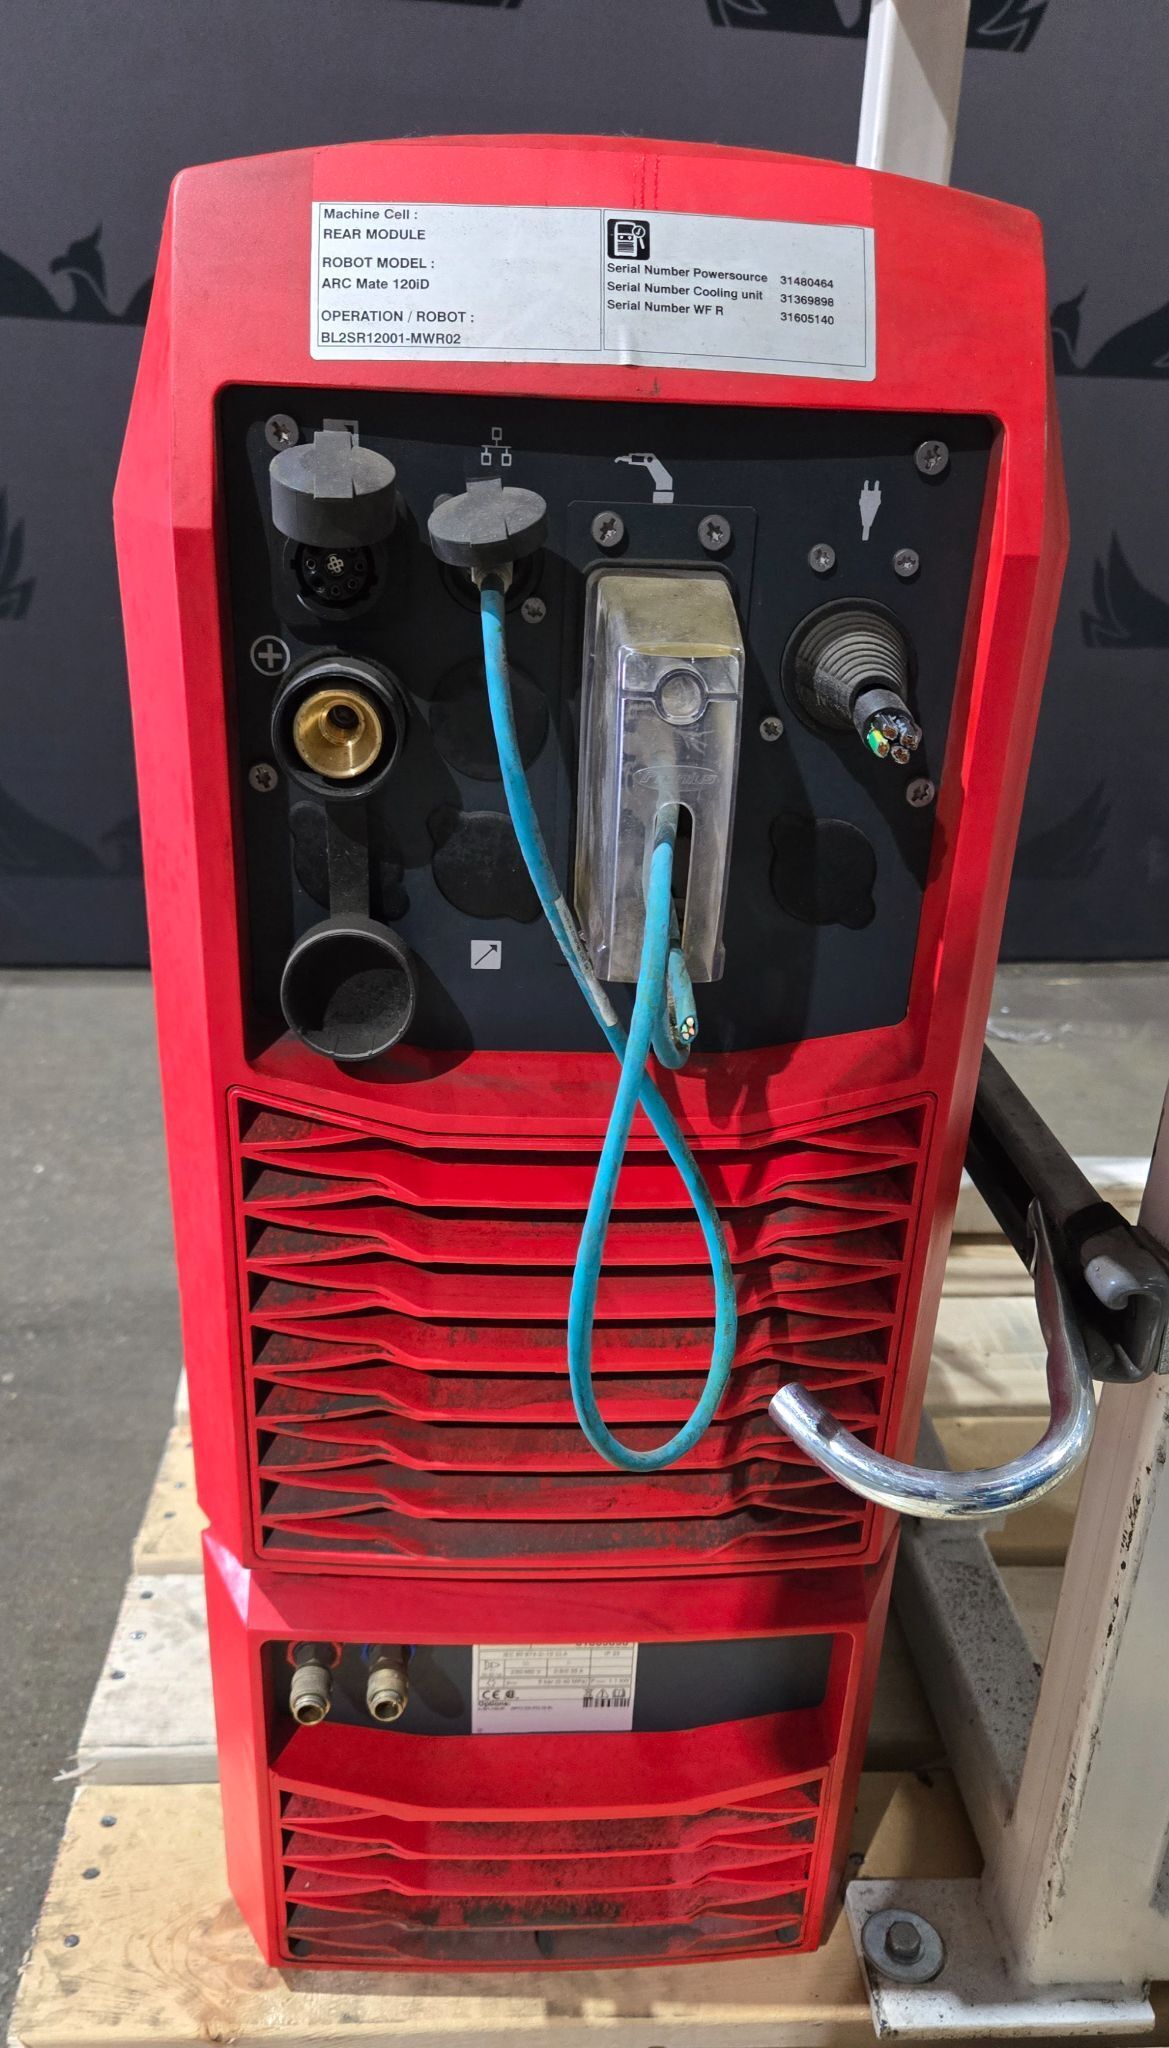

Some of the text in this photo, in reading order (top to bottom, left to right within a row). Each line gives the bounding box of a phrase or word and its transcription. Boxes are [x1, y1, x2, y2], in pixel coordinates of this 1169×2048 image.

[323, 209, 380, 219] Machine
[384, 209, 410, 220] Cell
[323, 229, 425, 240] REAR MODULE
[322, 258, 372, 268] ROBOT
[377, 258, 427, 269] MODEL
[607, 263, 834, 288] Serial Number Powersource 31480464
[322, 279, 430, 290] ARC Mate 120iD
[607, 281, 834, 307] Serial Number Cooling unit 31369898
[321, 311, 403, 322] OPERATION
[416, 311, 466, 323] ROBOT
[607, 300, 834, 325] Serial Number WF R 31605140
[321, 332, 461, 344] BL2SR12001-MWR02
